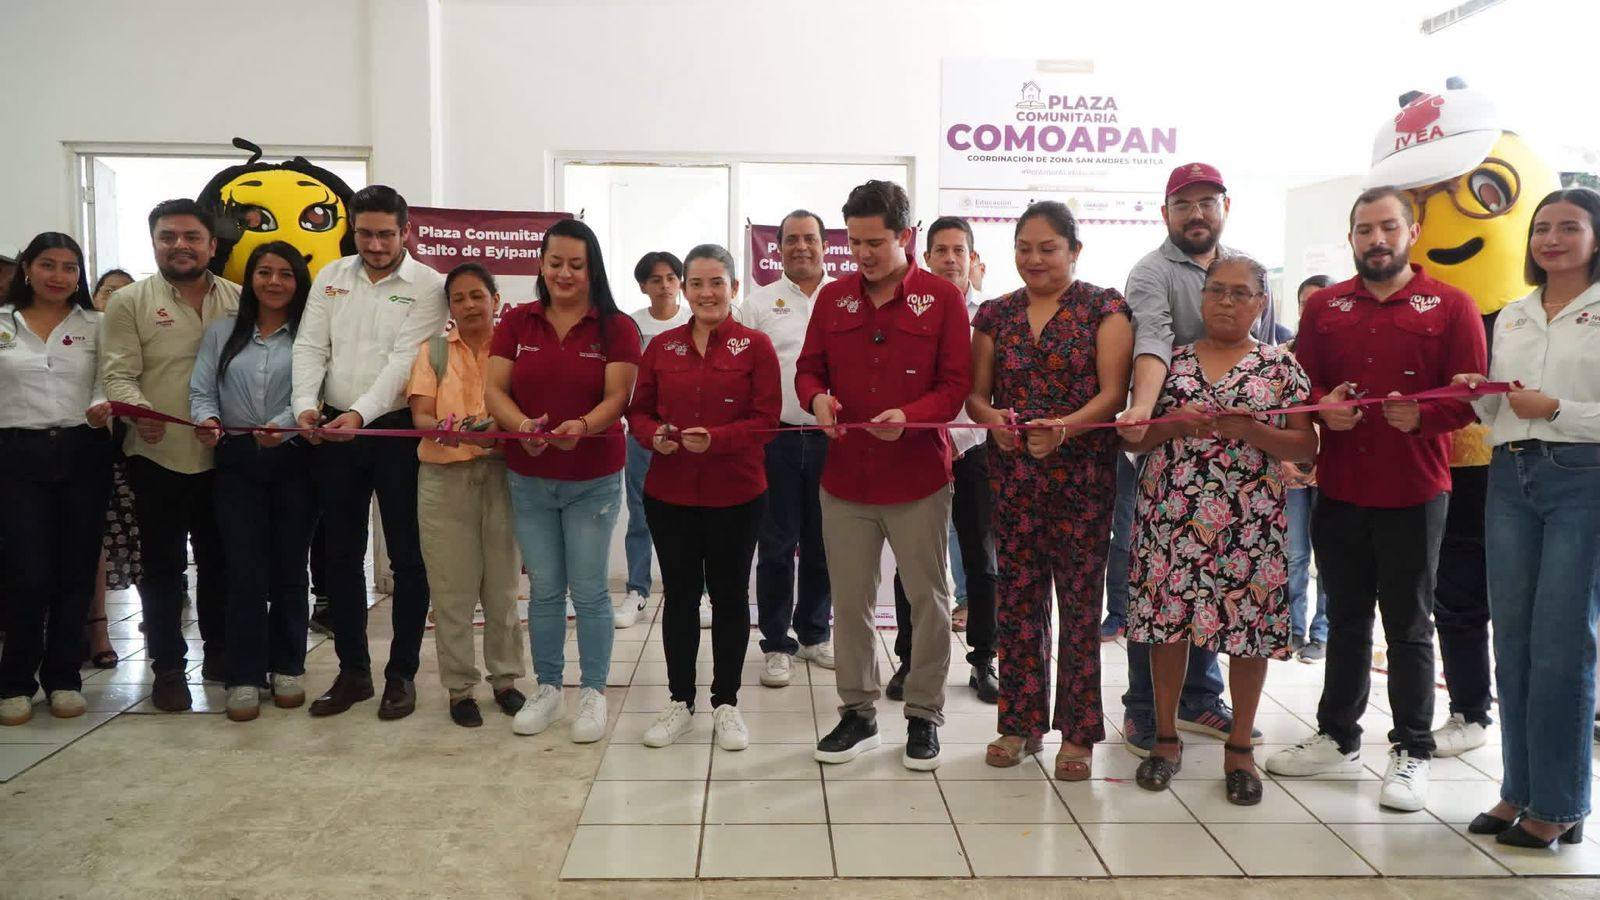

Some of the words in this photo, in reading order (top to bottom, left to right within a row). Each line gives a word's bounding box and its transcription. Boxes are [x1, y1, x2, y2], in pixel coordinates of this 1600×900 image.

[1048, 95, 1118, 110] PLAZA
[1016, 111, 1118, 123] COMUNITARIA
[946, 123, 1177, 154] COMOAPAN
[1394, 125, 1444, 151] IVEA
[419, 226, 460, 239] Plaza
[465, 228, 546, 241] Comunitar
[417, 244, 457, 256] Salto
[462, 245, 481, 257] de
[840, 262, 859, 272] de
